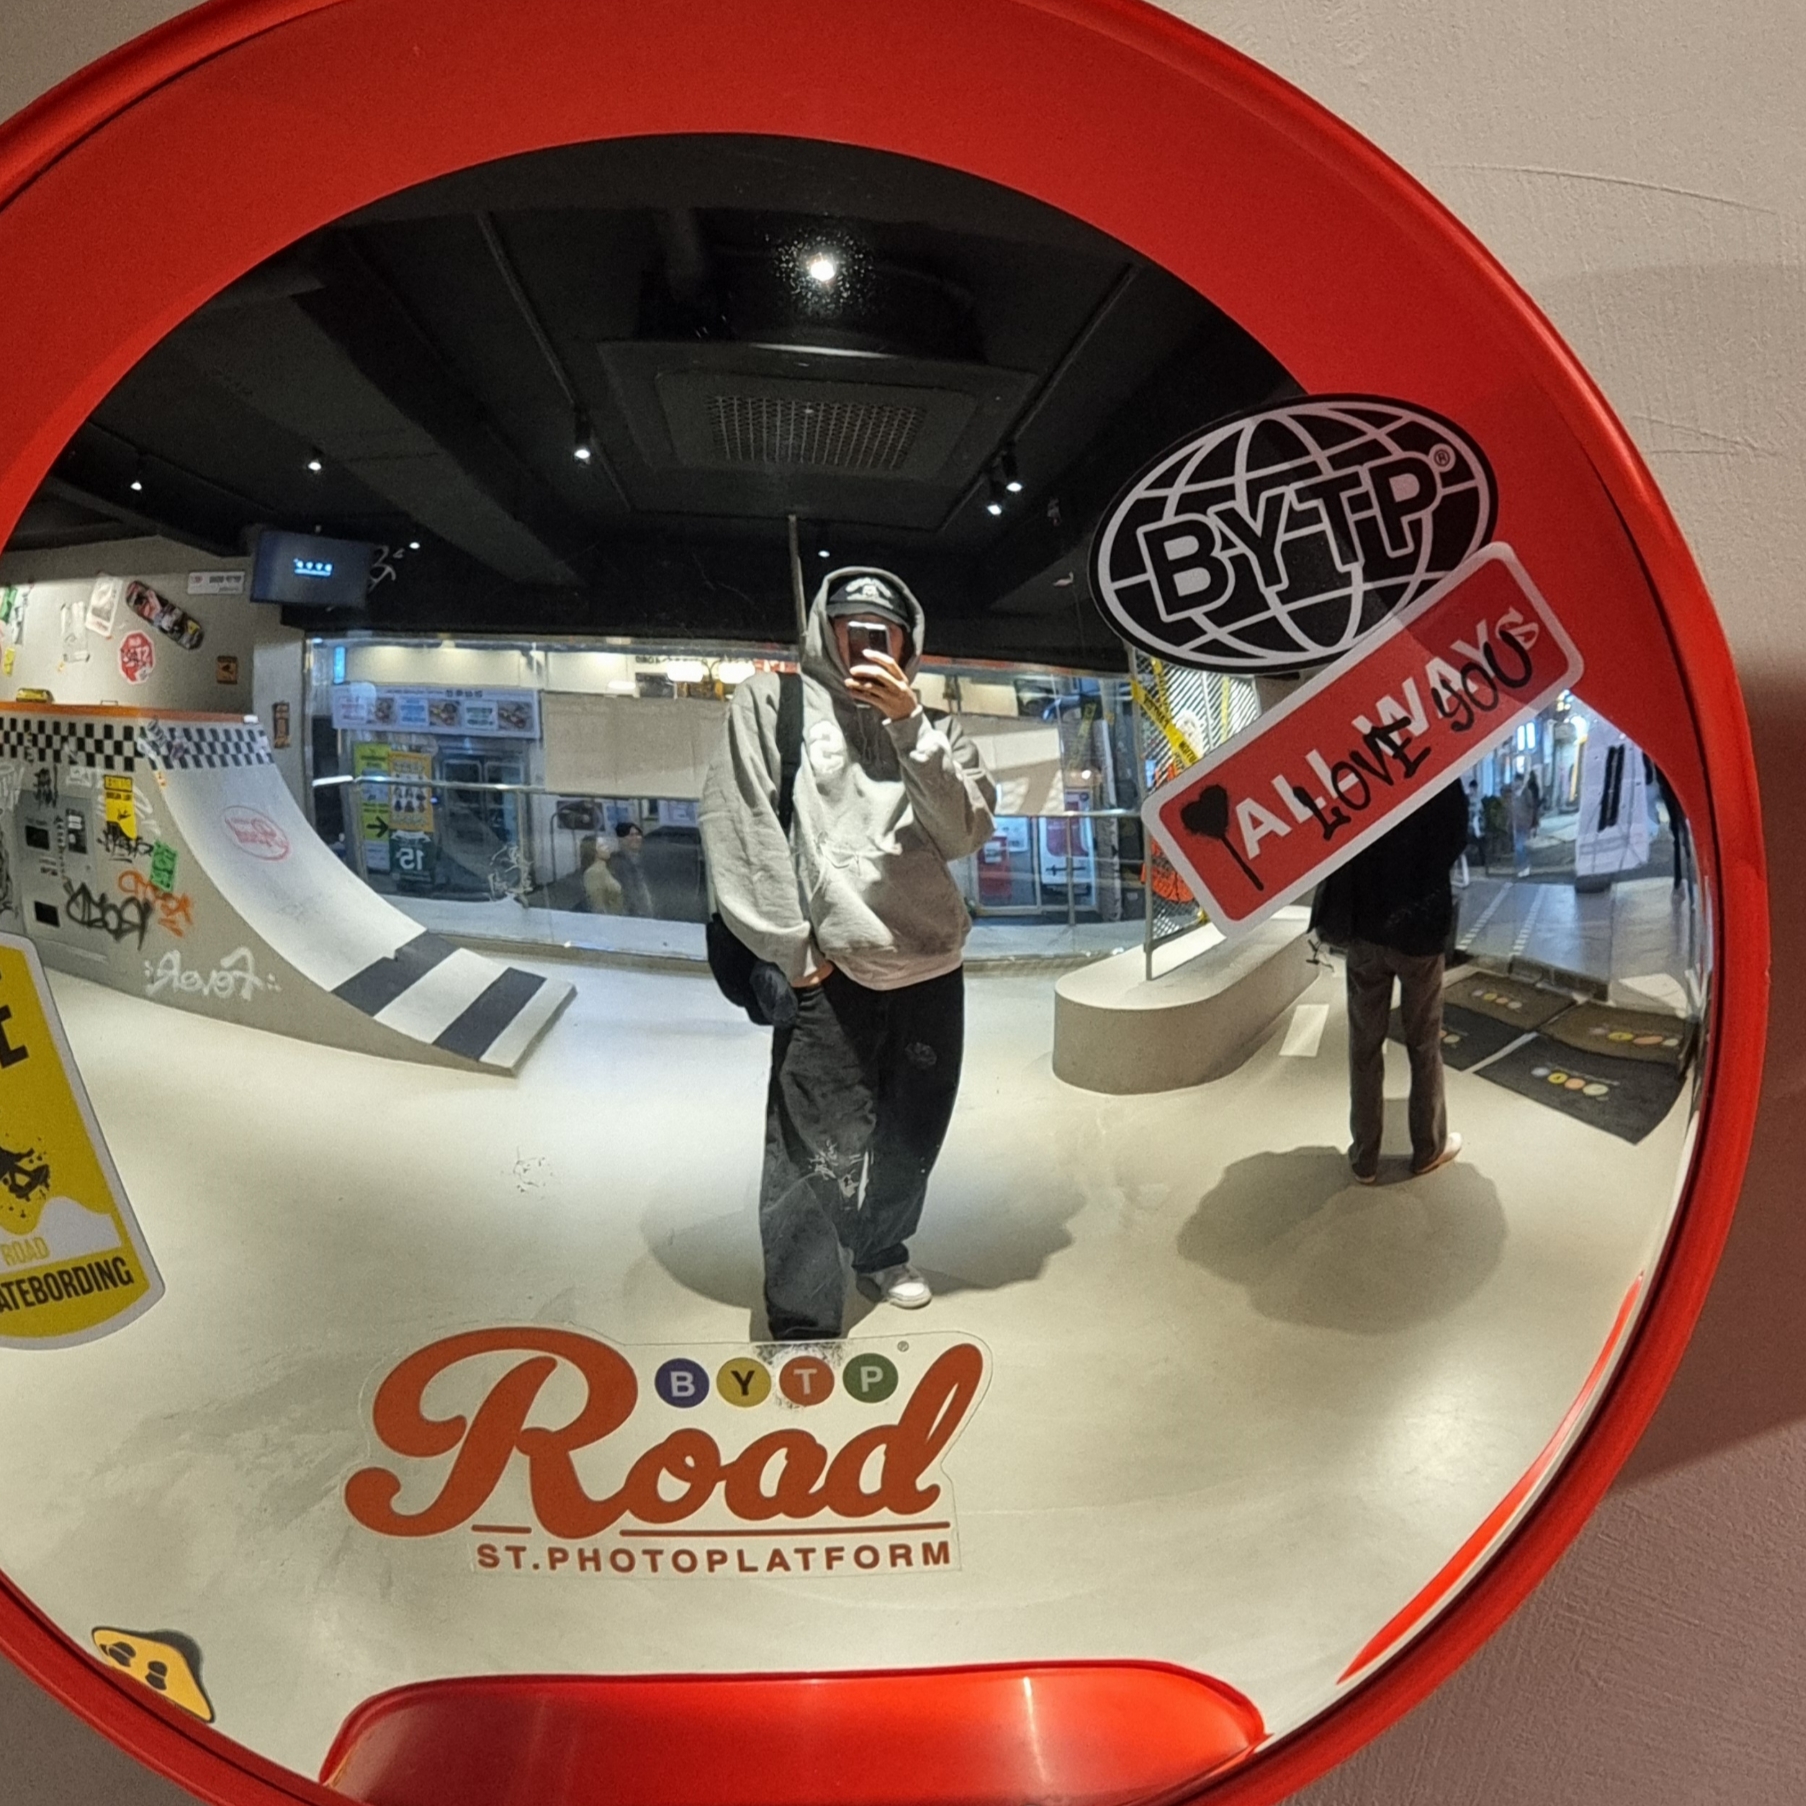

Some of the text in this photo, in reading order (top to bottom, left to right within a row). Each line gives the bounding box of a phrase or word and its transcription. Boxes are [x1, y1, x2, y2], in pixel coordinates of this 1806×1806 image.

[1137, 451, 1443, 621] BYTP
[1292, 716, 1431, 840] LOVE
[344, 1326, 984, 1539] Road
[476, 1540, 952, 1573] ST.PHOTOPLATFORM
